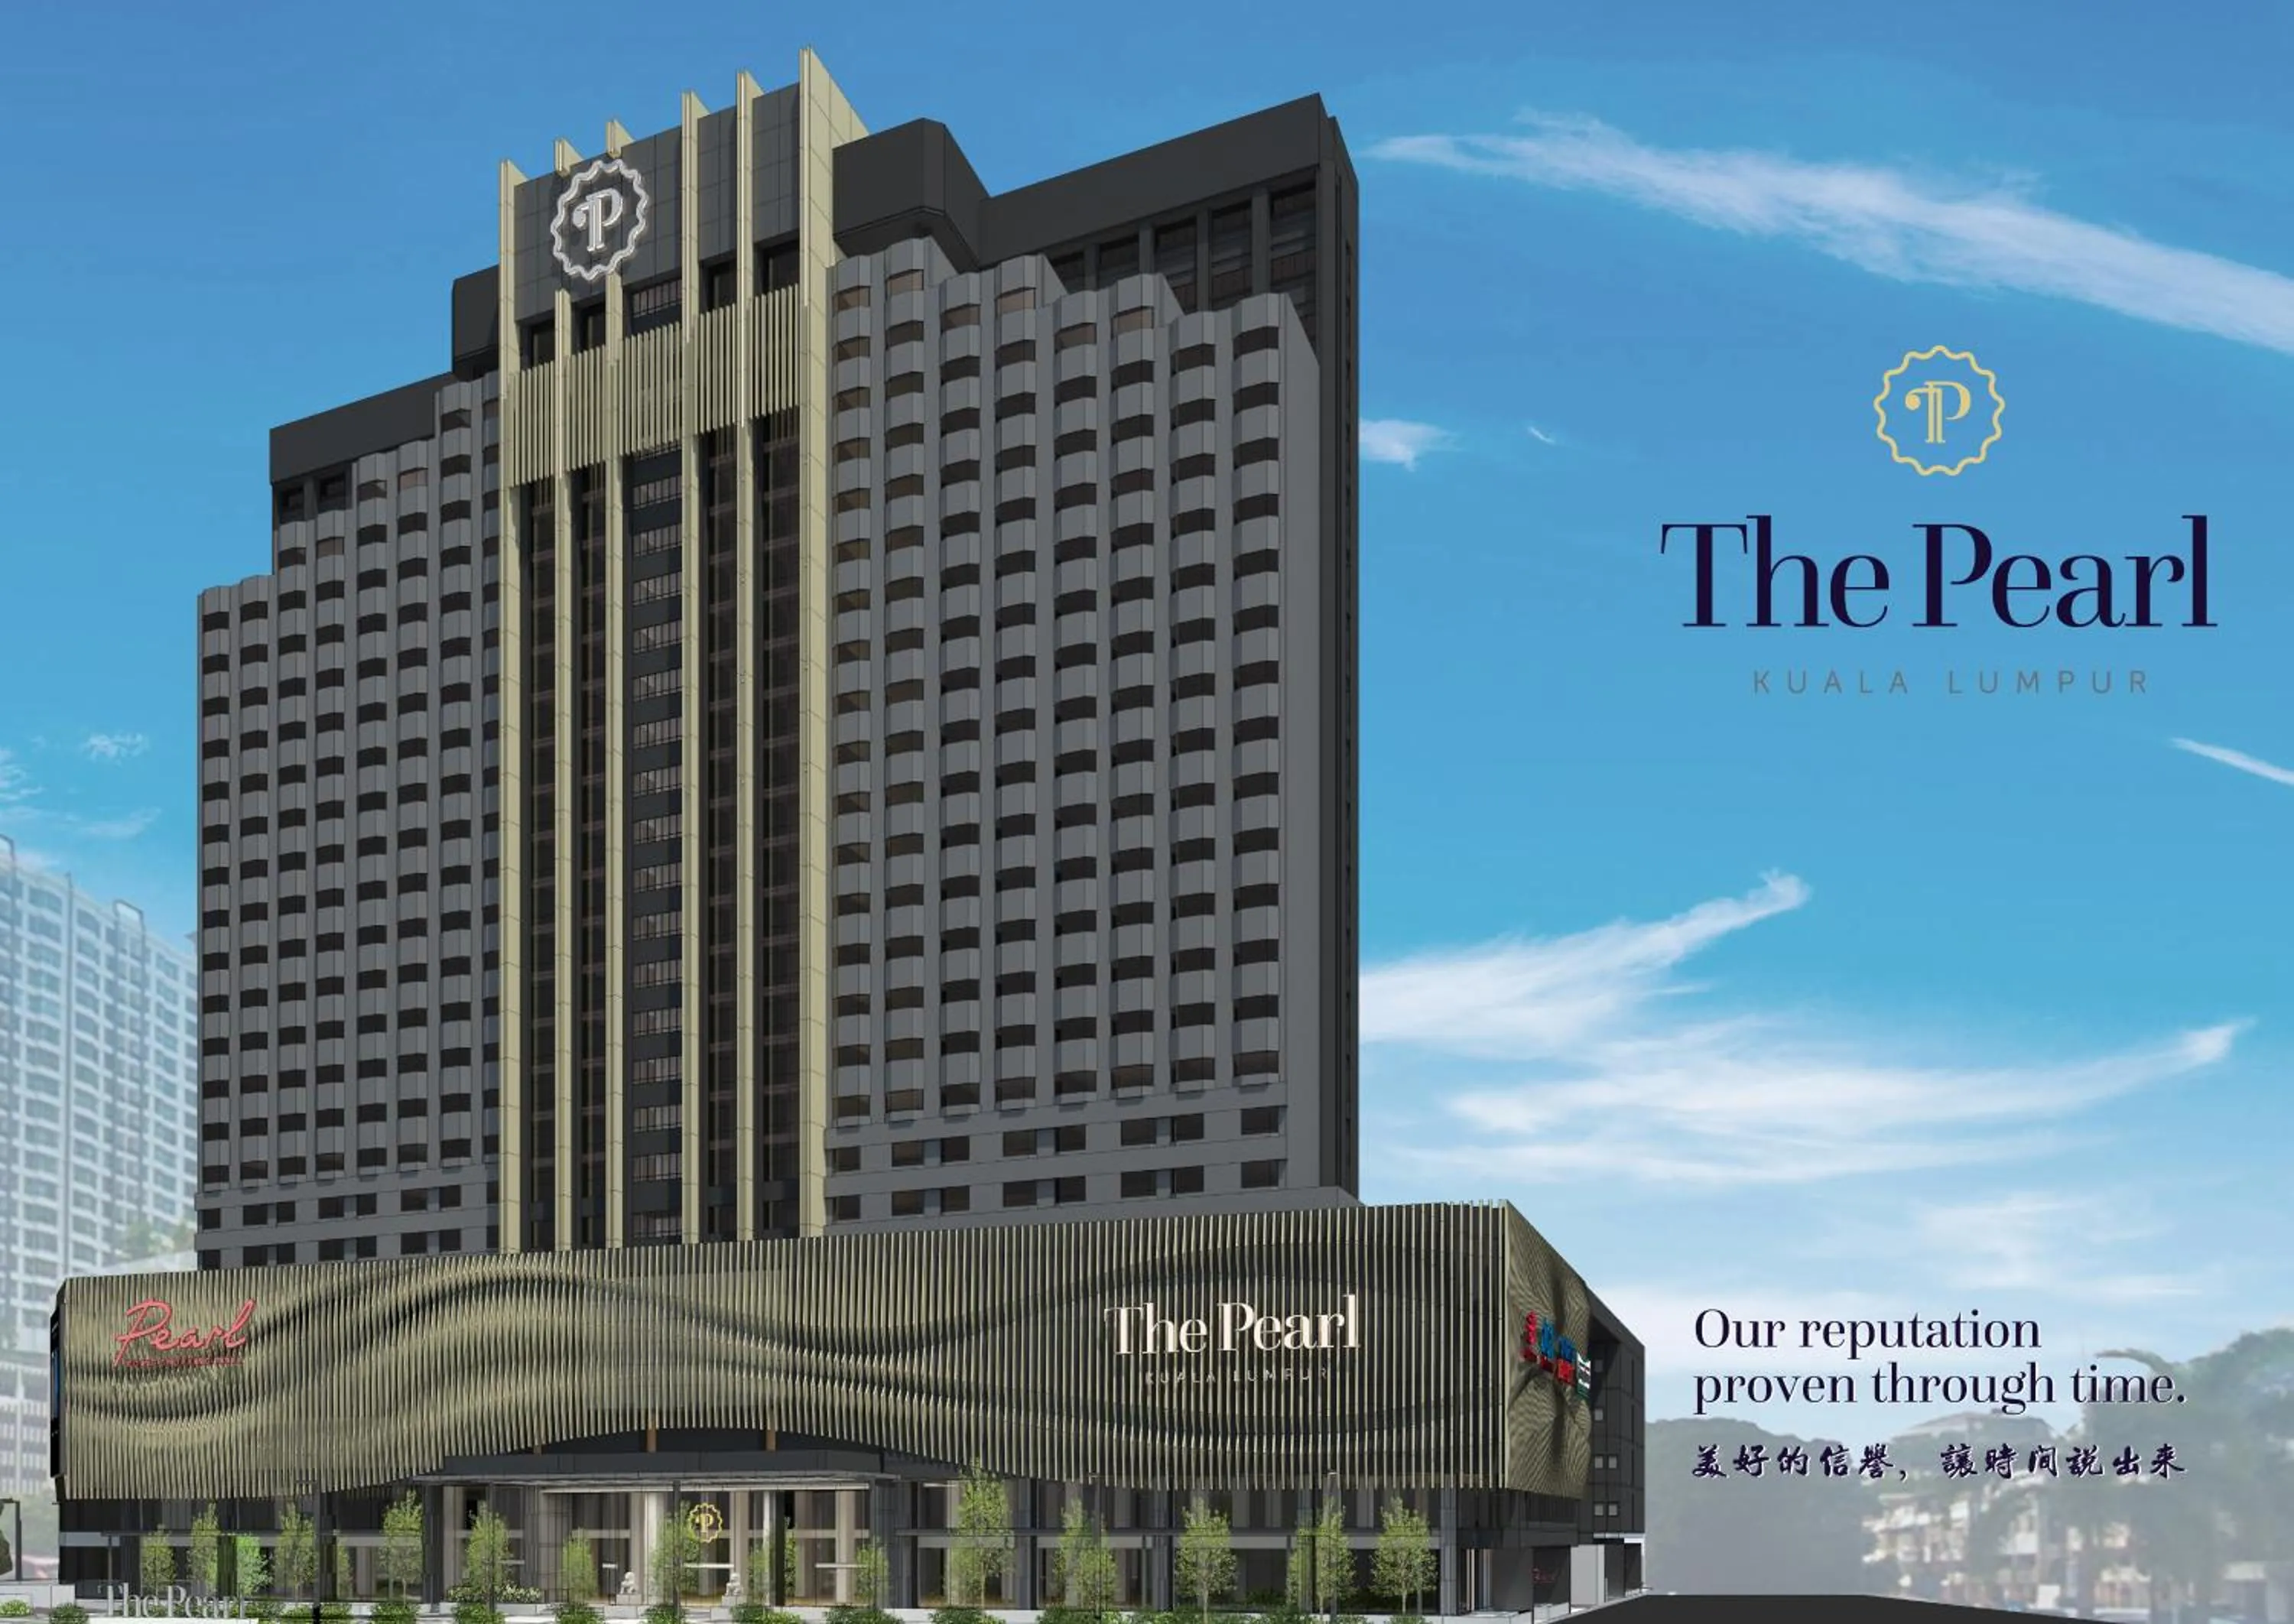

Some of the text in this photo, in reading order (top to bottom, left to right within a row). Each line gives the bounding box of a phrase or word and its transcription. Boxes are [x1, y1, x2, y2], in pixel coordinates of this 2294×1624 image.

[113, 1298, 256, 1367] Pearl
[1103, 1294, 1361, 1355] The Pearl
[97, 1582, 158, 1619] The
